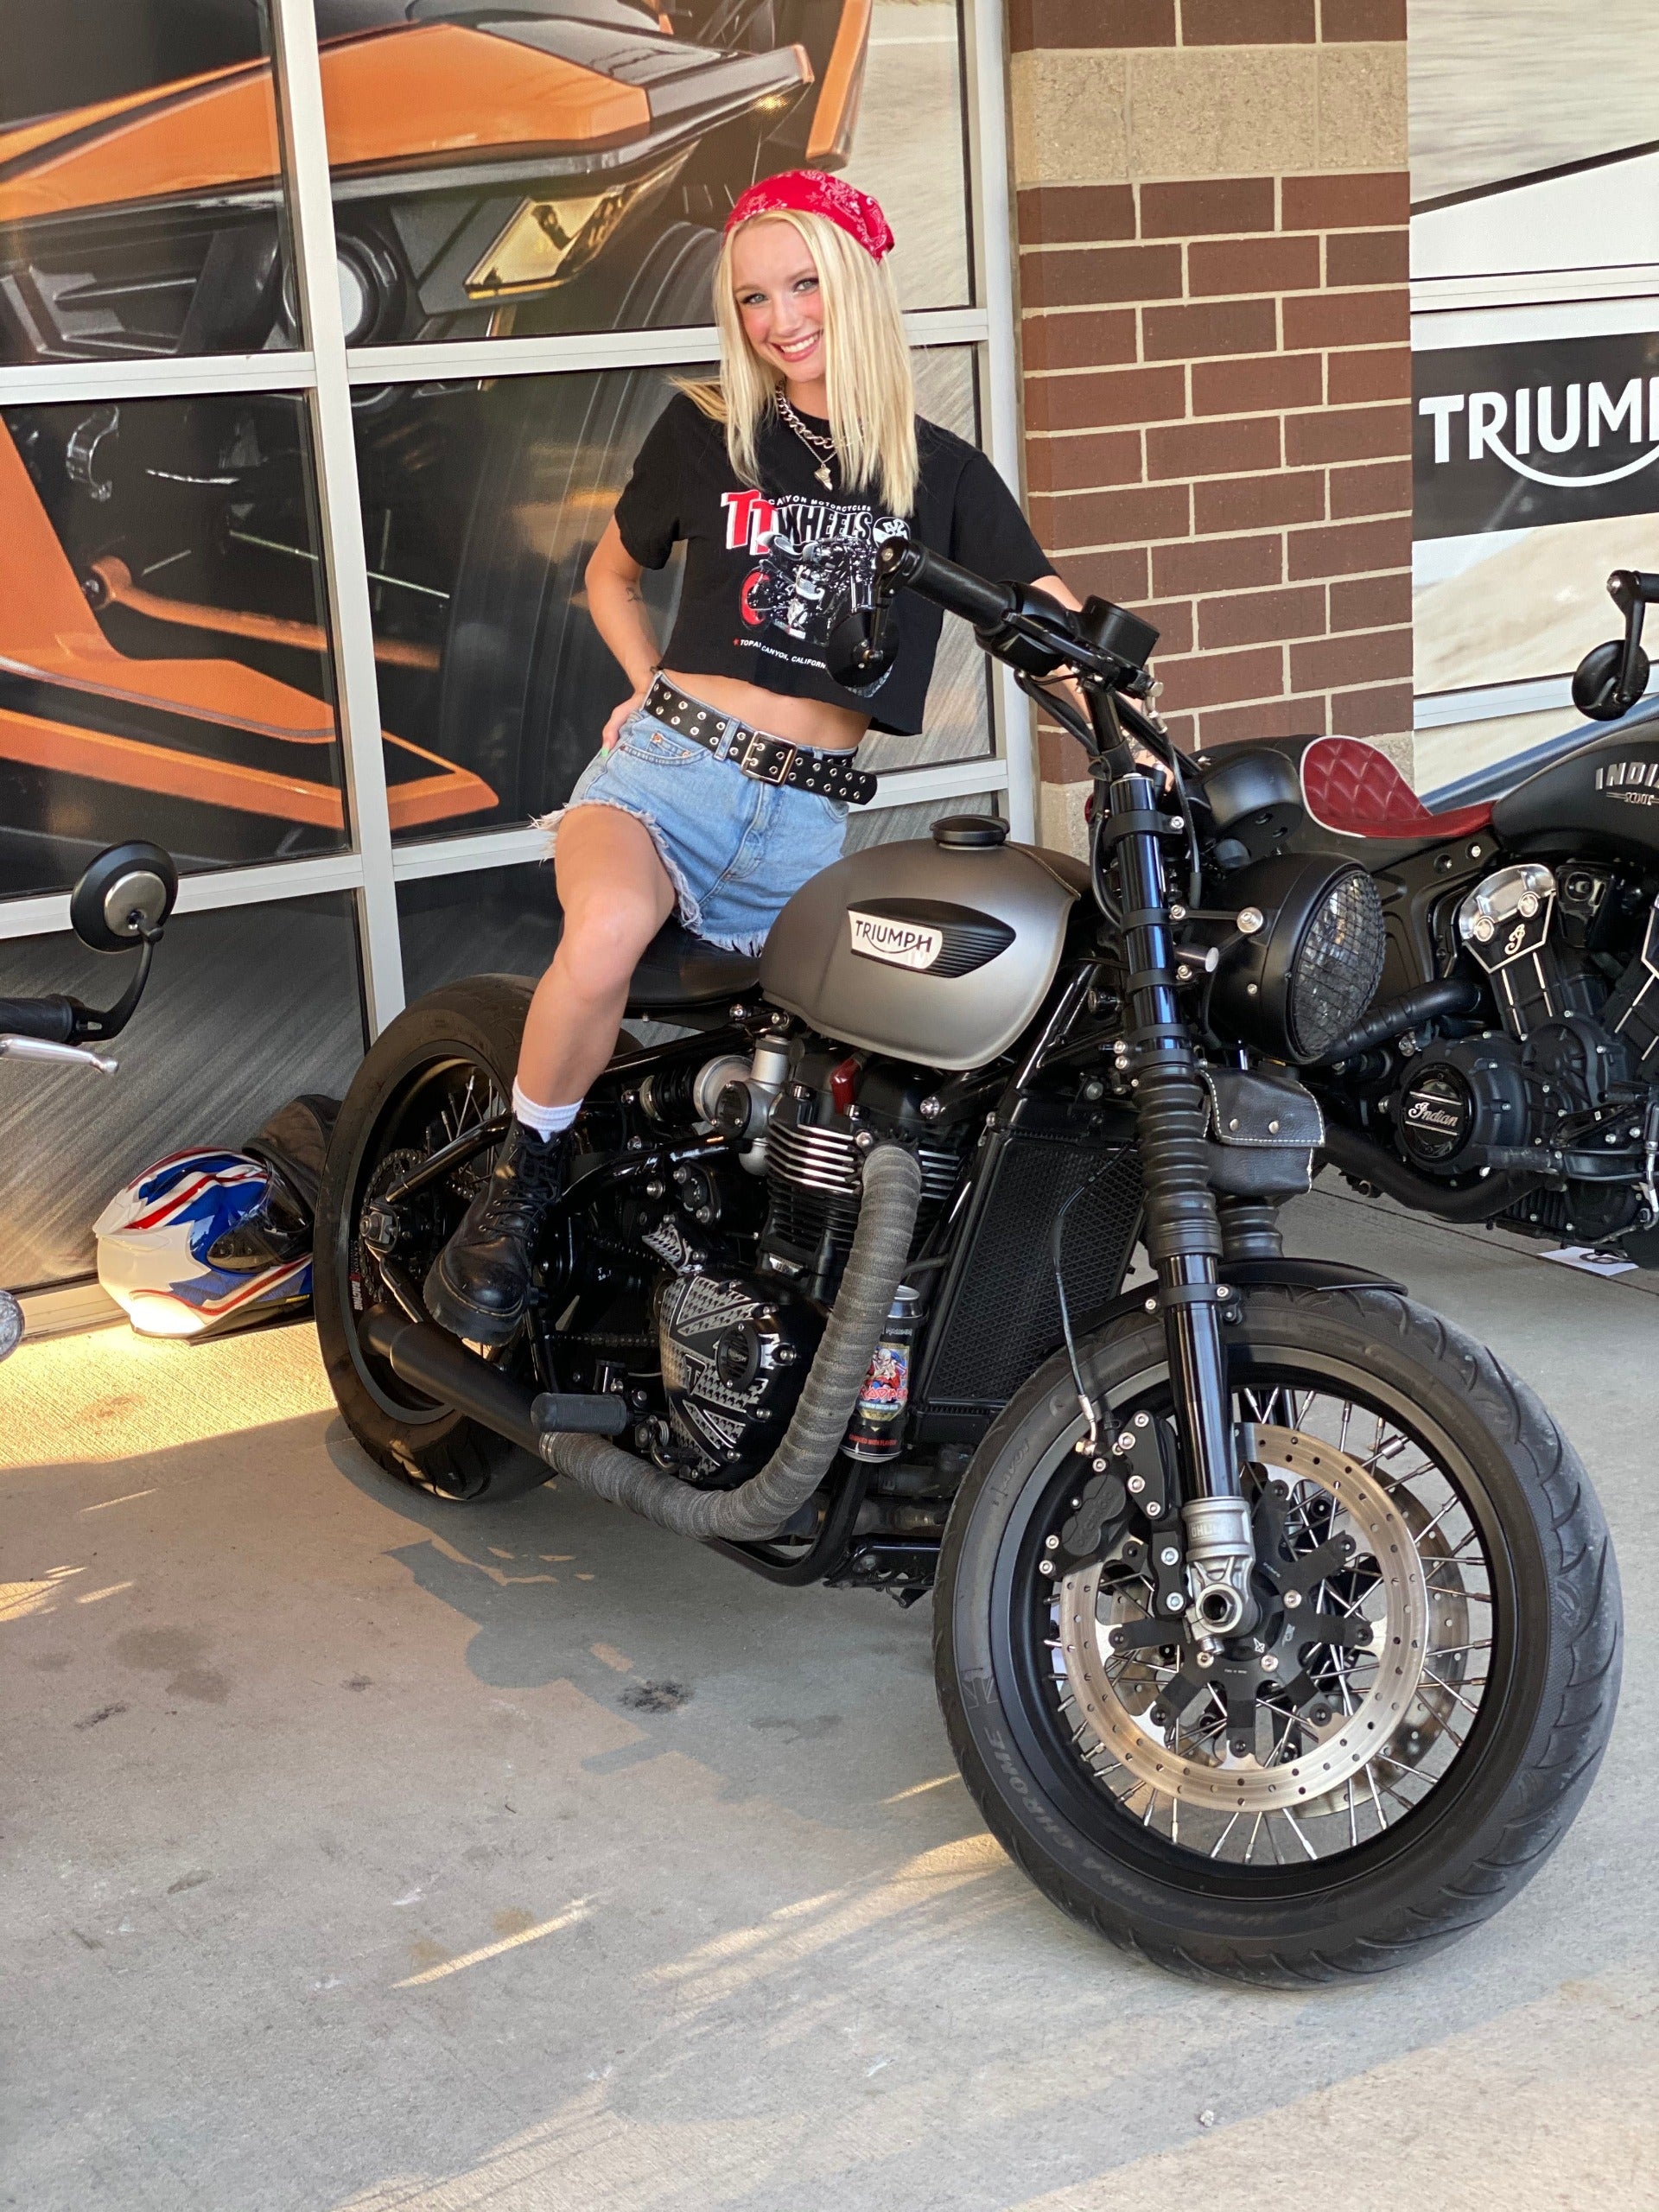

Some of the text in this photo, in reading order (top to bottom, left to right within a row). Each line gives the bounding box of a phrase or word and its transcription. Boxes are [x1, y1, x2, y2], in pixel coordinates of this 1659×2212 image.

[1419, 376, 1659, 487] TRIUM
[810, 499, 872, 512] MOTORCYCLES
[791, 656, 827, 669] CALIFORN
[1595, 762, 1659, 791] INDI
[855, 920, 933, 954] TRIUMPH
[1408, 1102, 1459, 1127] Indian
